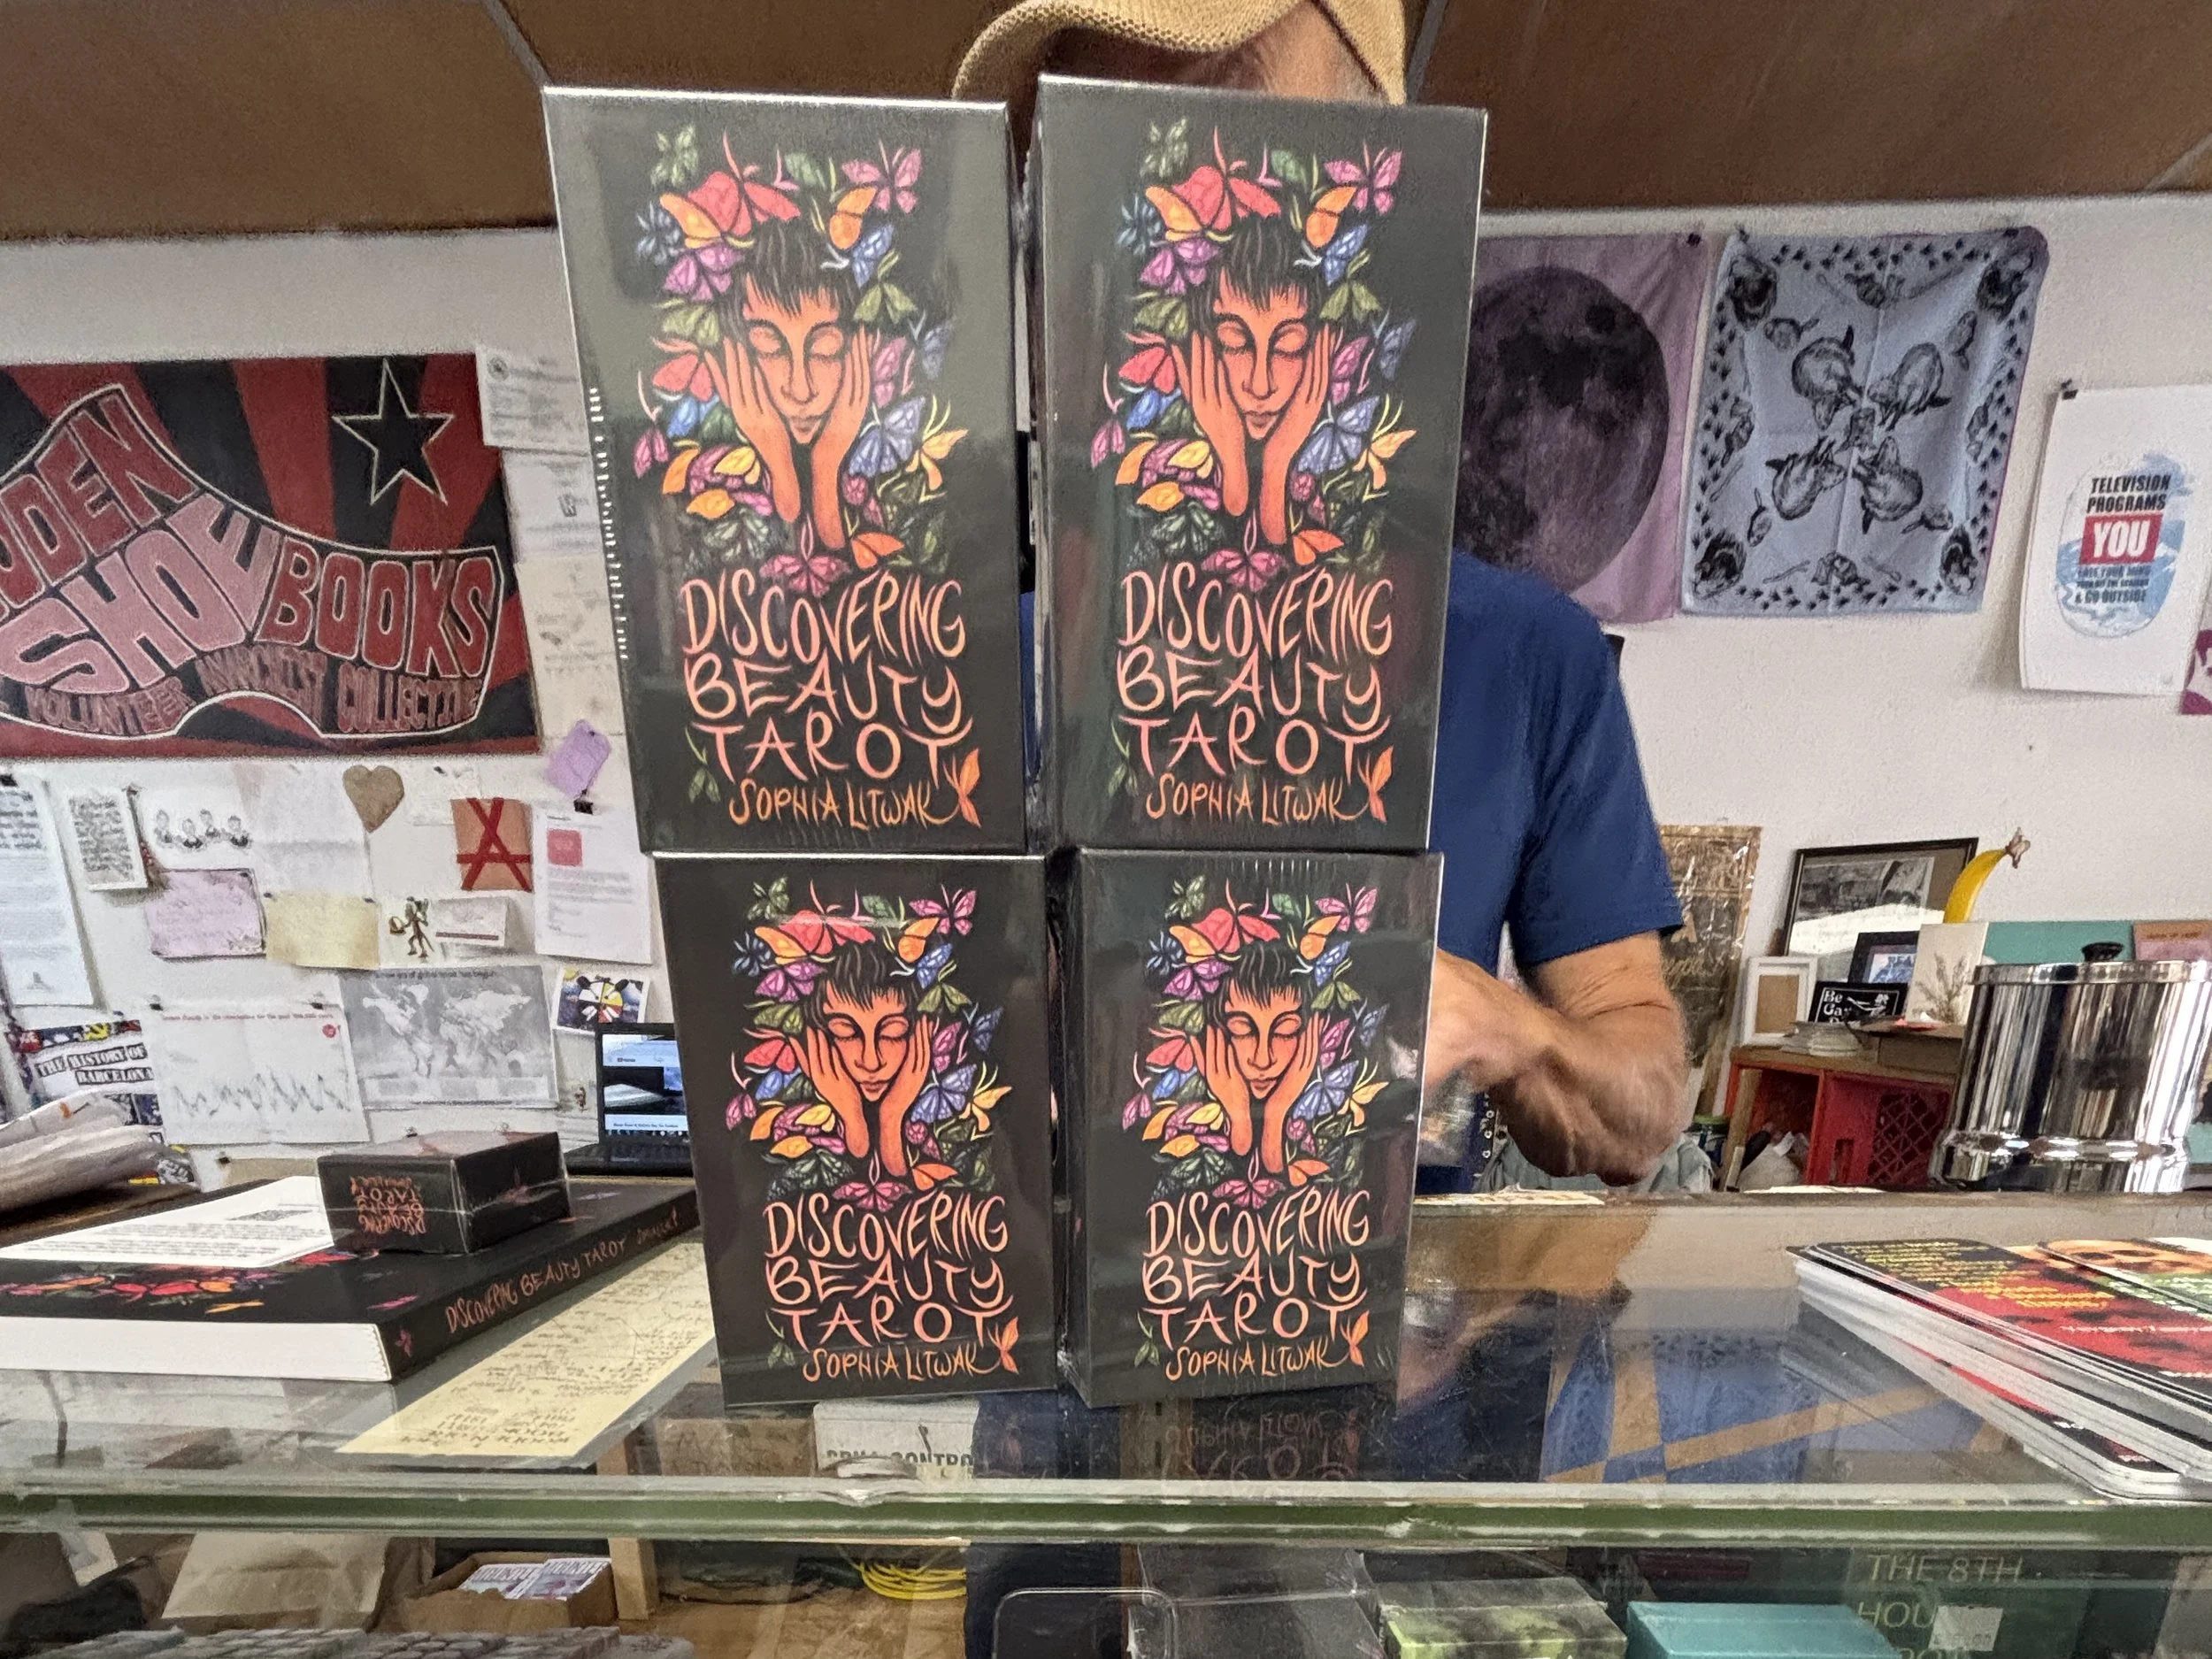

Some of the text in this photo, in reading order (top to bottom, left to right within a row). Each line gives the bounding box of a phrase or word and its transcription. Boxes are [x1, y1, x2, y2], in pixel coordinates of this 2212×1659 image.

[2086, 494, 2167, 513] PROGRAMS
[2091, 474, 2171, 494] TELEVISION
[2093, 519, 2150, 558] YOU
[0, 492, 280, 695] SHOE
[254, 535, 497, 679] BOOKS
[681, 568, 966, 666] DISCOVERING
[1117, 562, 1393, 664] DISCOVERING
[684, 647, 962, 733] BEAUTY
[1117, 643, 1381, 731] BEAUTY
[691, 707, 972, 789] TAROT
[1118, 703, 1390, 785] TAROT
[729, 777, 957, 831] SOPHIA LITWAK
[1146, 773, 1370, 826] SOPHIA LITWAK
[1824, 990, 1843, 1003] Be
[67, 1047, 127, 1069] HISTORY
[763, 1187, 1008, 1262] DISCOVERING
[1142, 1185, 1371, 1258] DISCOVERING
[445, 1238, 626, 1333] DISCOVERING BEAUTY TAROT
[765, 1248, 1003, 1309] BEAUTY
[1142, 1245, 1360, 1304] BEAUTY
[770, 1293, 1014, 1353] TAROT
[1141, 1288, 1368, 1351] TAROT
[803, 1341, 1000, 1382] SOPHIA LITWAK
[1165, 1336, 1350, 1381] SOPHIA LITWAK
[1867, 1555, 2024, 1584] THE 8TH
[1858, 1601, 1938, 1628] HOU
